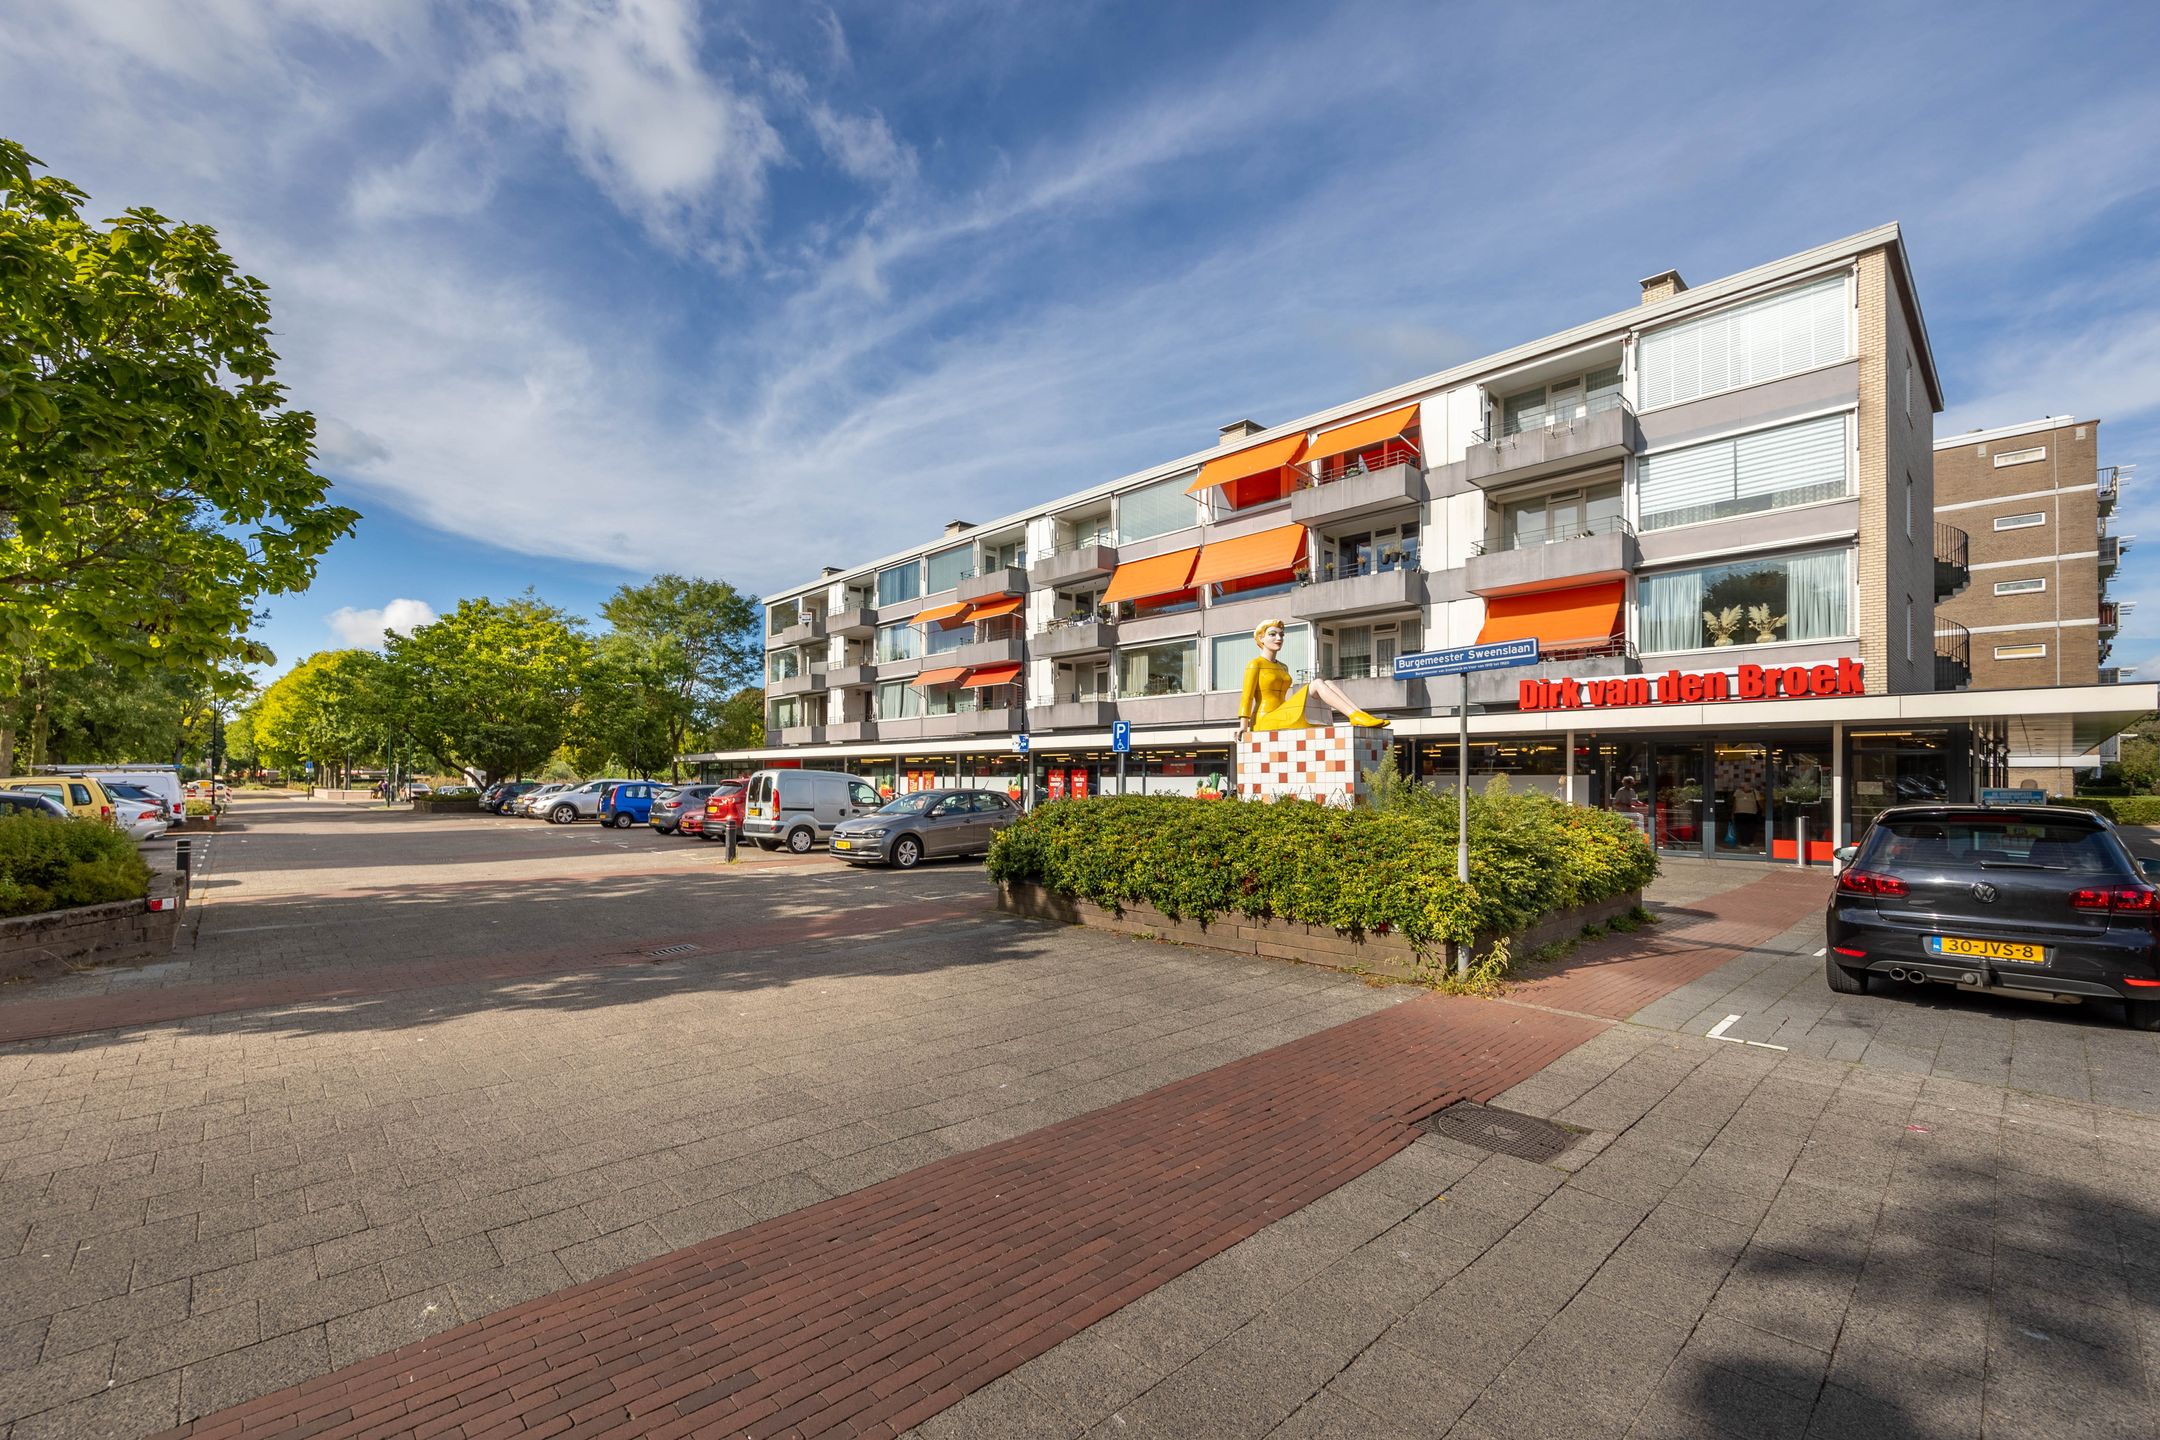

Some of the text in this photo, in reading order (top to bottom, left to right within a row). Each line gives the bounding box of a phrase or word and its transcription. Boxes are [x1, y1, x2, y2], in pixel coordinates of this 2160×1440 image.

[1399, 653, 1464, 668] Burgemeester
[1468, 644, 1530, 660] Sweenslaan
[1519, 657, 1864, 709] Dirk van den Broek
[1116, 723, 1126, 739] P
[1948, 939, 2034, 958] 30-JVS-8
